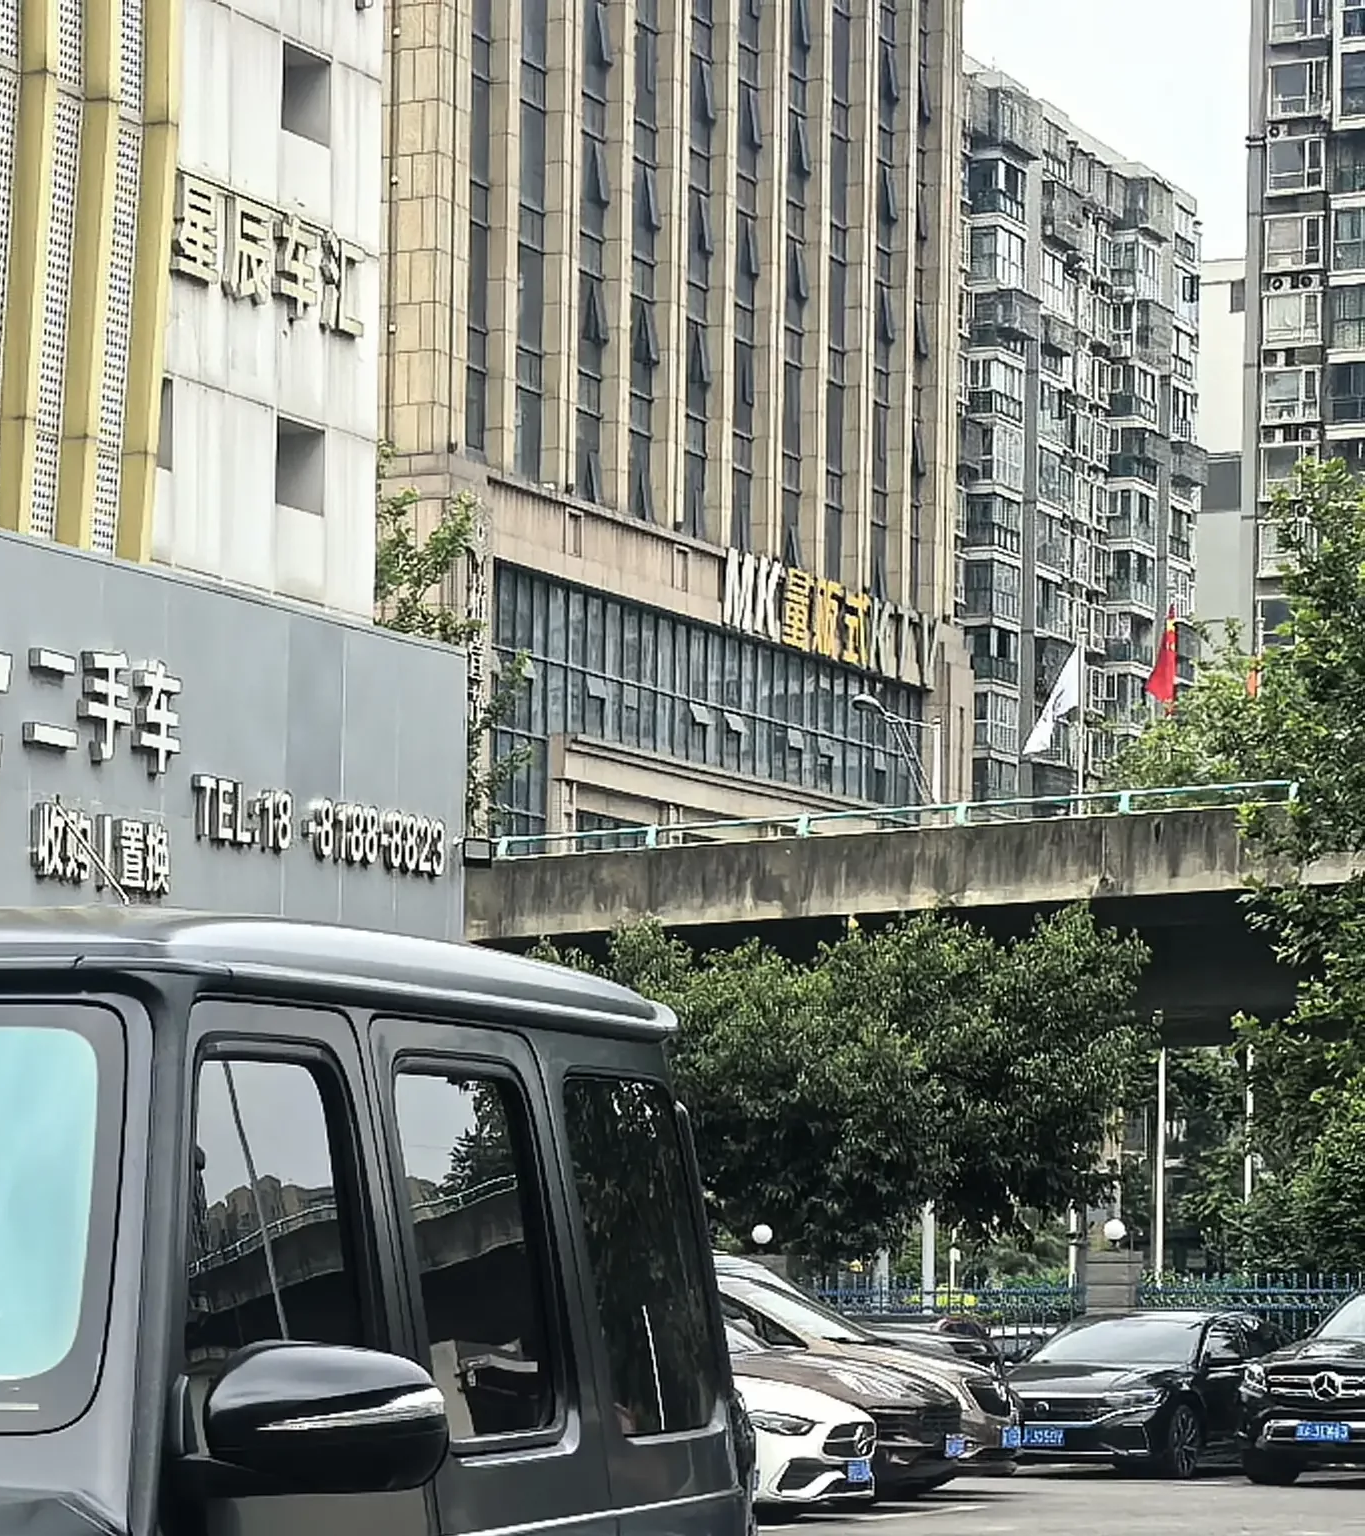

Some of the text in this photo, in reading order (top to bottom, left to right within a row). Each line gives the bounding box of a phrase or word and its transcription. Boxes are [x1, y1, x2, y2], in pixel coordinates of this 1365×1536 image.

[171, 171, 366, 338] 星辰车汇
[23, 647, 183, 776] 二手车
